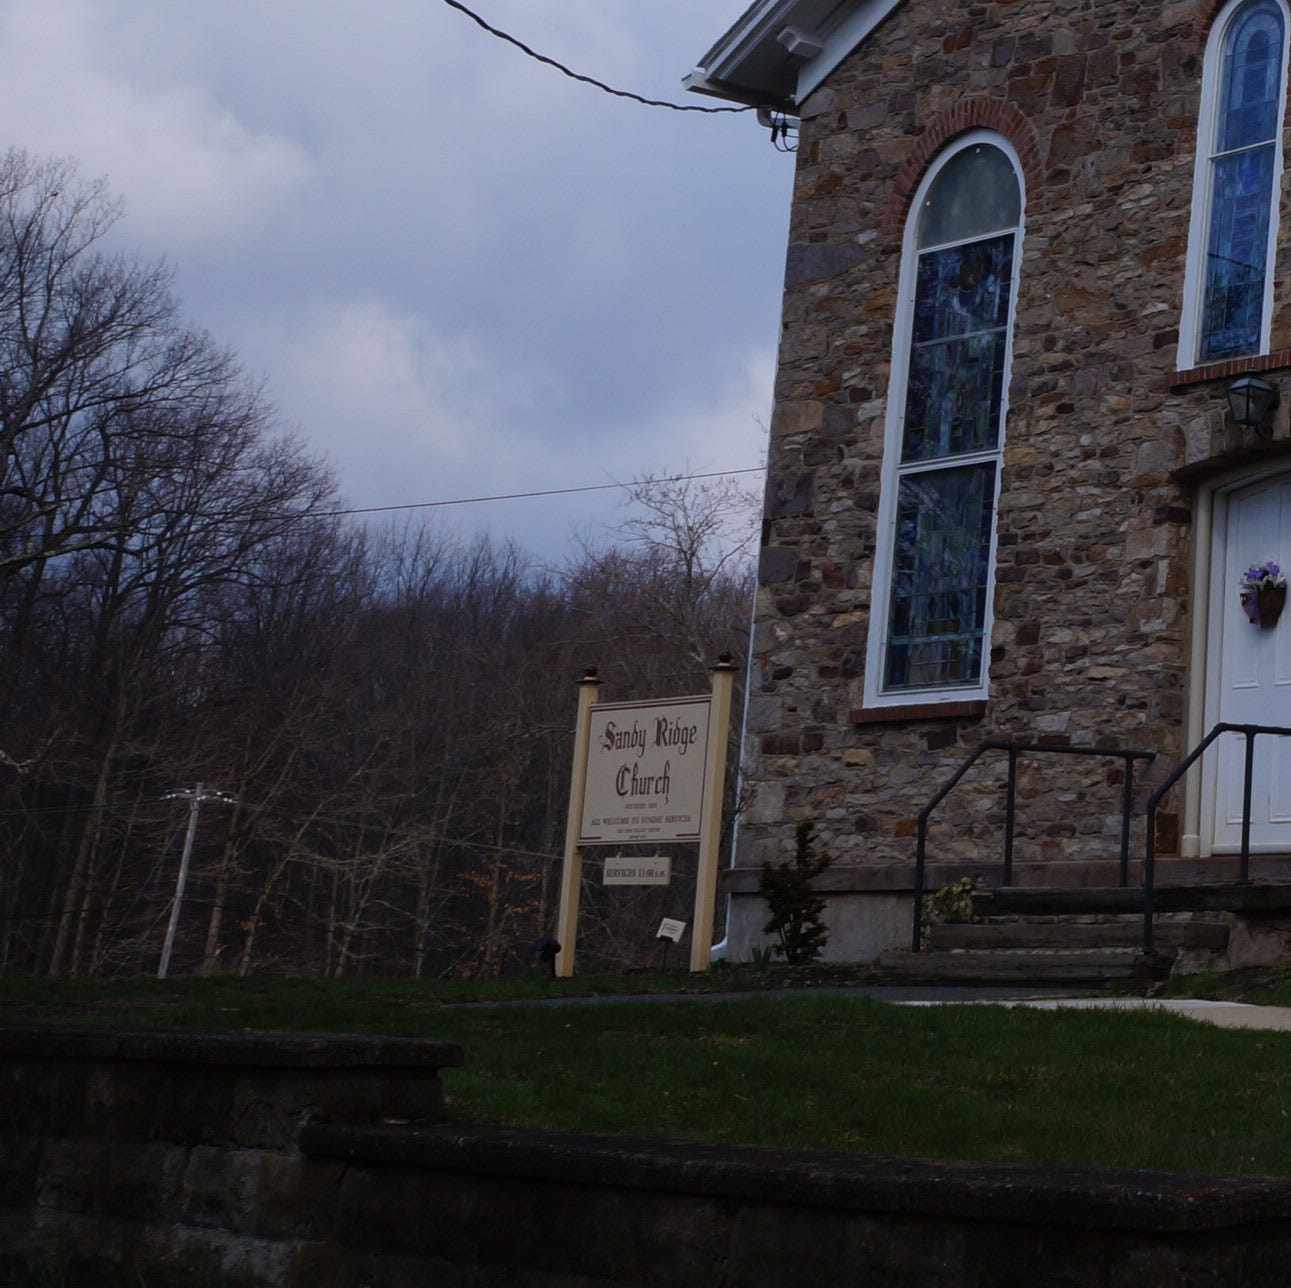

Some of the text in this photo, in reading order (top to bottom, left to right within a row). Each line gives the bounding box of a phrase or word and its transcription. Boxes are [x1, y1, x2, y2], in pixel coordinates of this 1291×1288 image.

[601, 716, 697, 758] Sandy Ridge
[616, 760, 670, 805] Church
[603, 817, 629, 825] WELCOME
[665, 815, 691, 823] SERVICES
[606, 868, 636, 878] SERVICES
